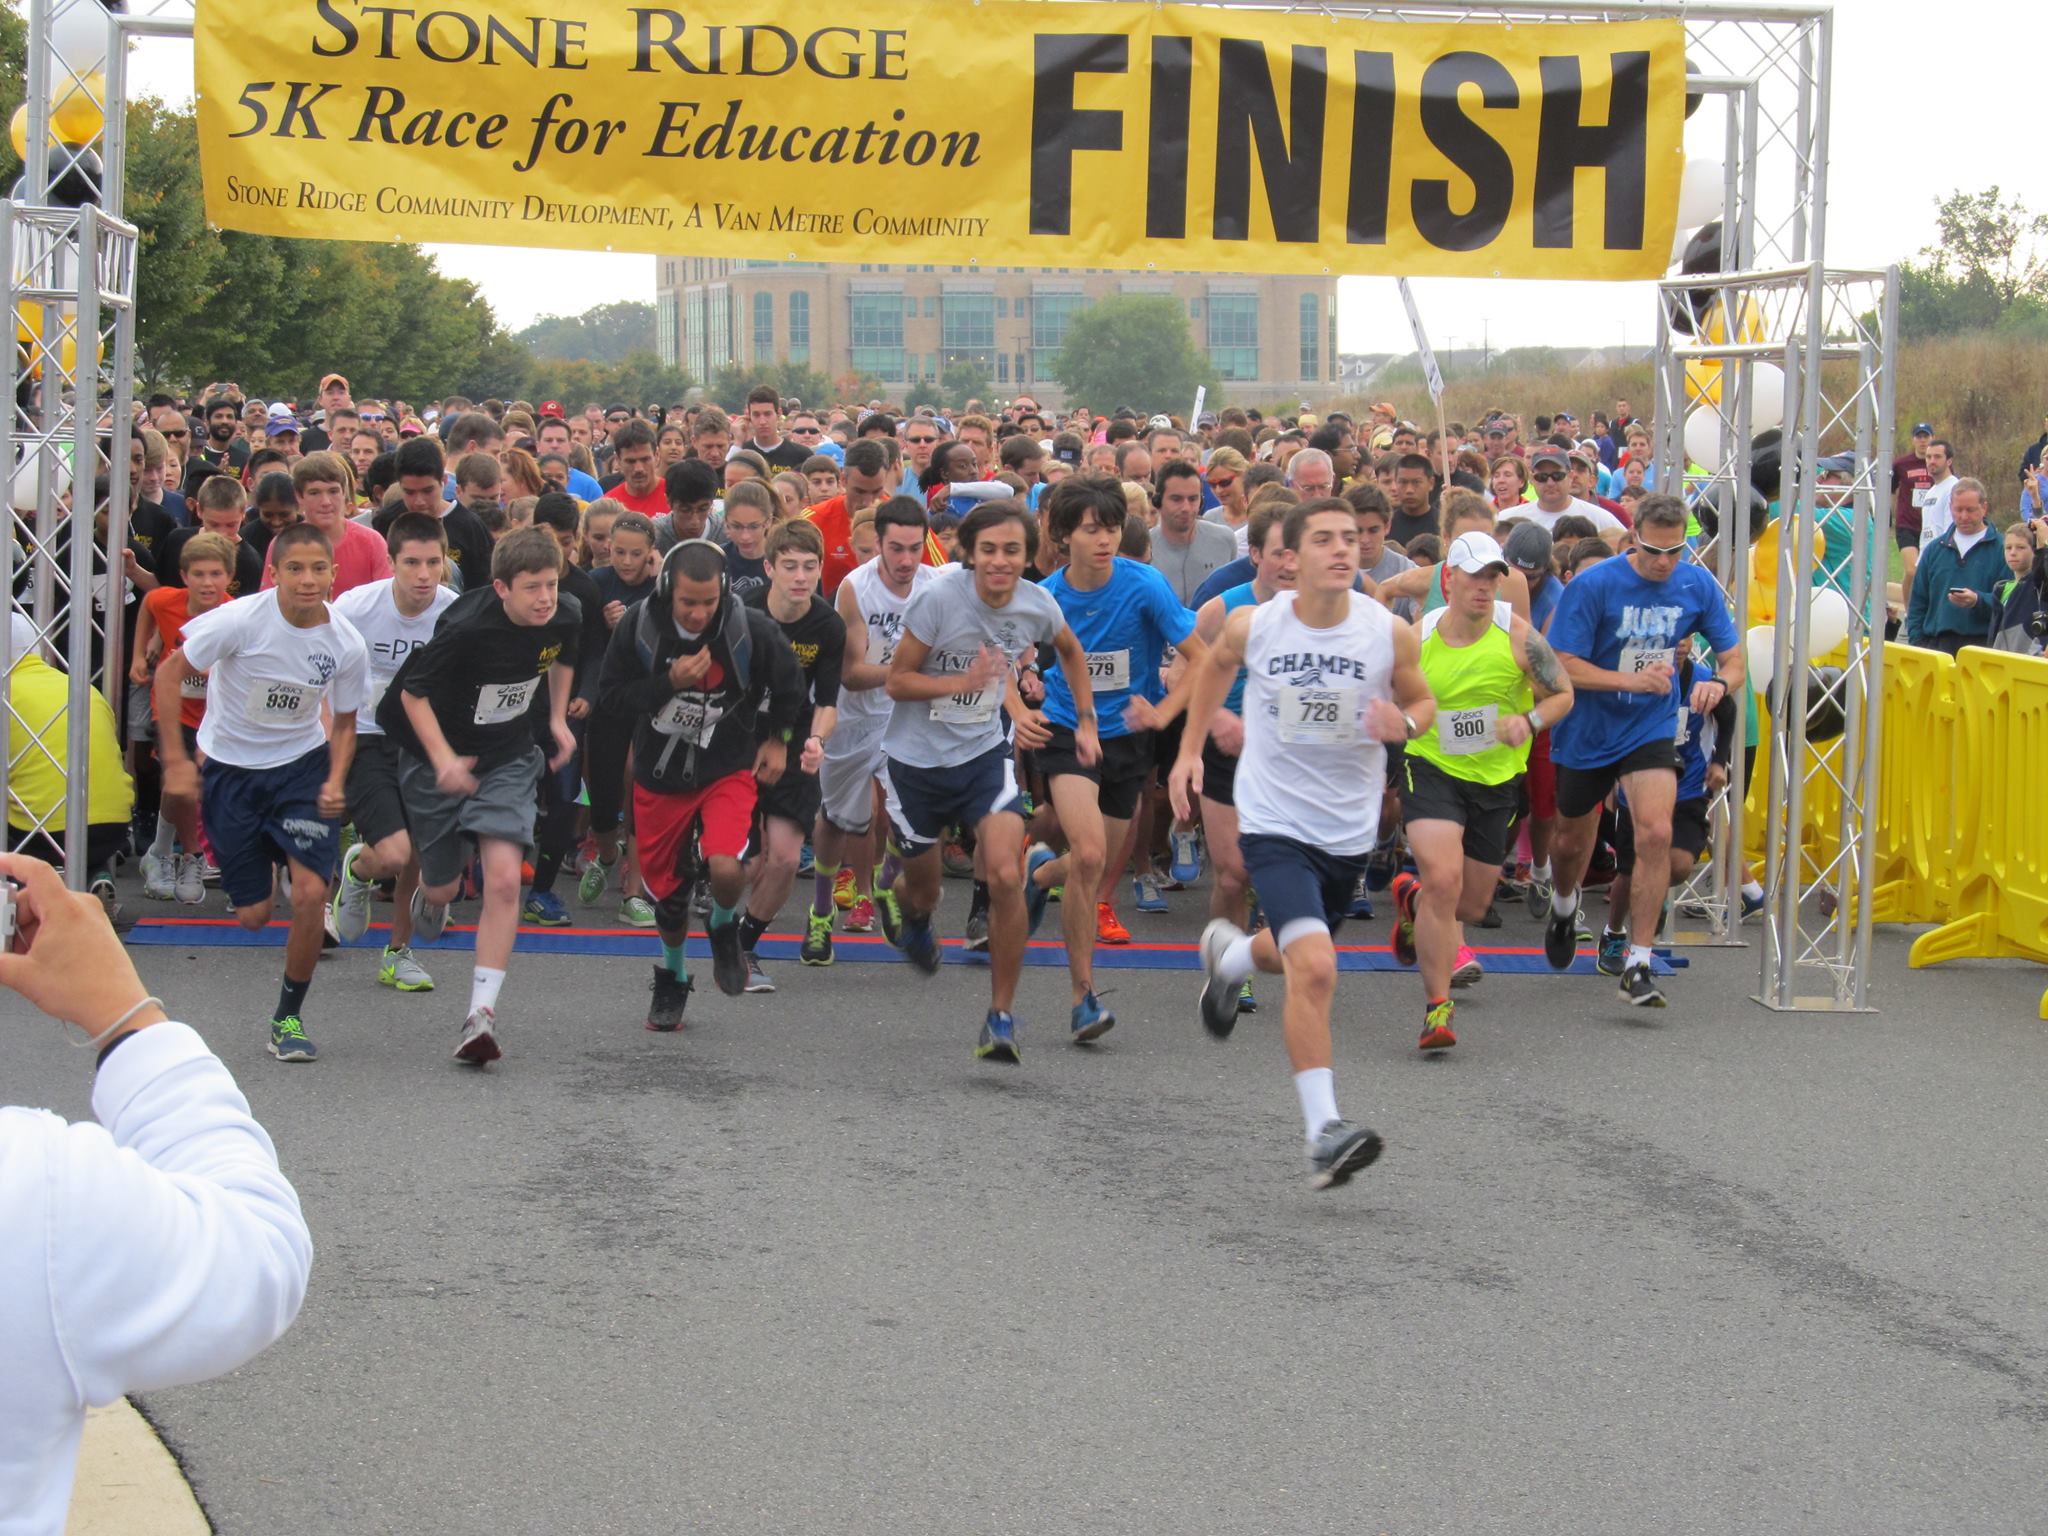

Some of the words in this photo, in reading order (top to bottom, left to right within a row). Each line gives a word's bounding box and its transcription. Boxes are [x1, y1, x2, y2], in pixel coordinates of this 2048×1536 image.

[312, 0, 588, 70] STONE
[627, 8, 909, 80] RIDGE
[229, 81, 340, 141] 5K
[348, 86, 509, 151] Race
[513, 93, 626, 172] for
[643, 100, 981, 168] Education
[1029, 33, 1651, 252] FINISH
[227, 175, 289, 207] STONE
[296, 181, 368, 213] RIDGE
[376, 186, 515, 220] COMMUNITY
[521, 195, 674, 231] DEVLOPMENT,
[683, 202, 703, 228] A
[712, 203, 762, 231] VAN
[768, 205, 844, 234] METRE
[852, 207, 990, 238] COMMUNITY
[1615, 605, 1684, 639] JUST
[1086, 662, 1115, 676] 579
[1268, 652, 1367, 681] CHAMPE
[266, 693, 300, 710] 936
[497, 691, 527, 708] 763
[952, 690, 984, 706] 407
[1301, 702, 1339, 722] 728
[1453, 719, 1485, 737] 800
